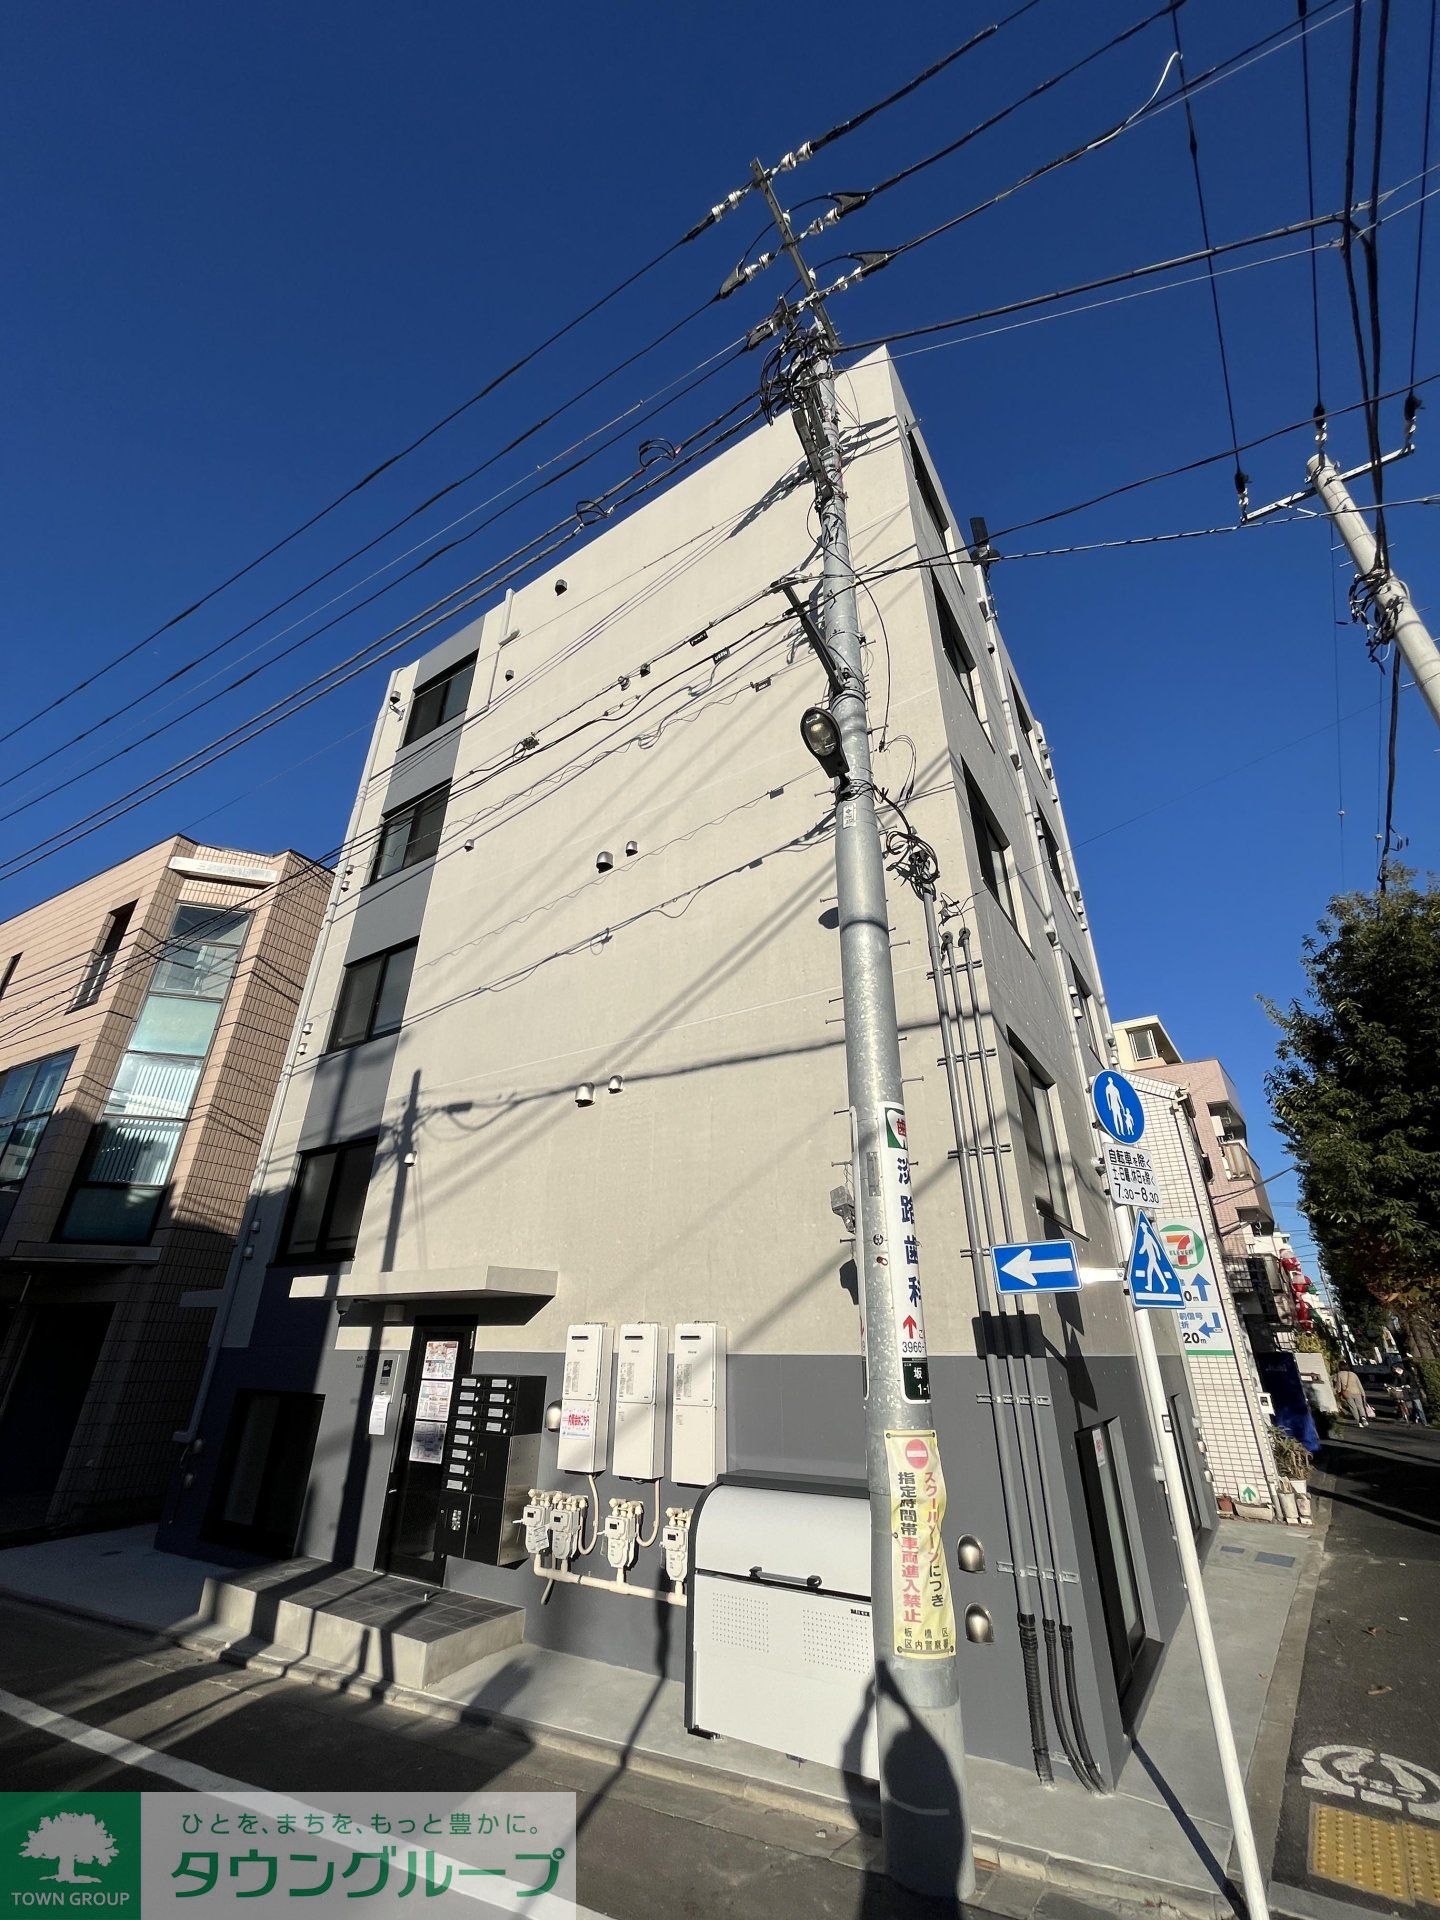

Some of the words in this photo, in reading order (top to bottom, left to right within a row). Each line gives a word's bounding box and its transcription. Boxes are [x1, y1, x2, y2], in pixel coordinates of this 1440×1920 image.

[1108, 1149, 1152, 1169] 自転車を除く
[898, 1471, 922, 1623] 指定時間帯車両進入禁止
